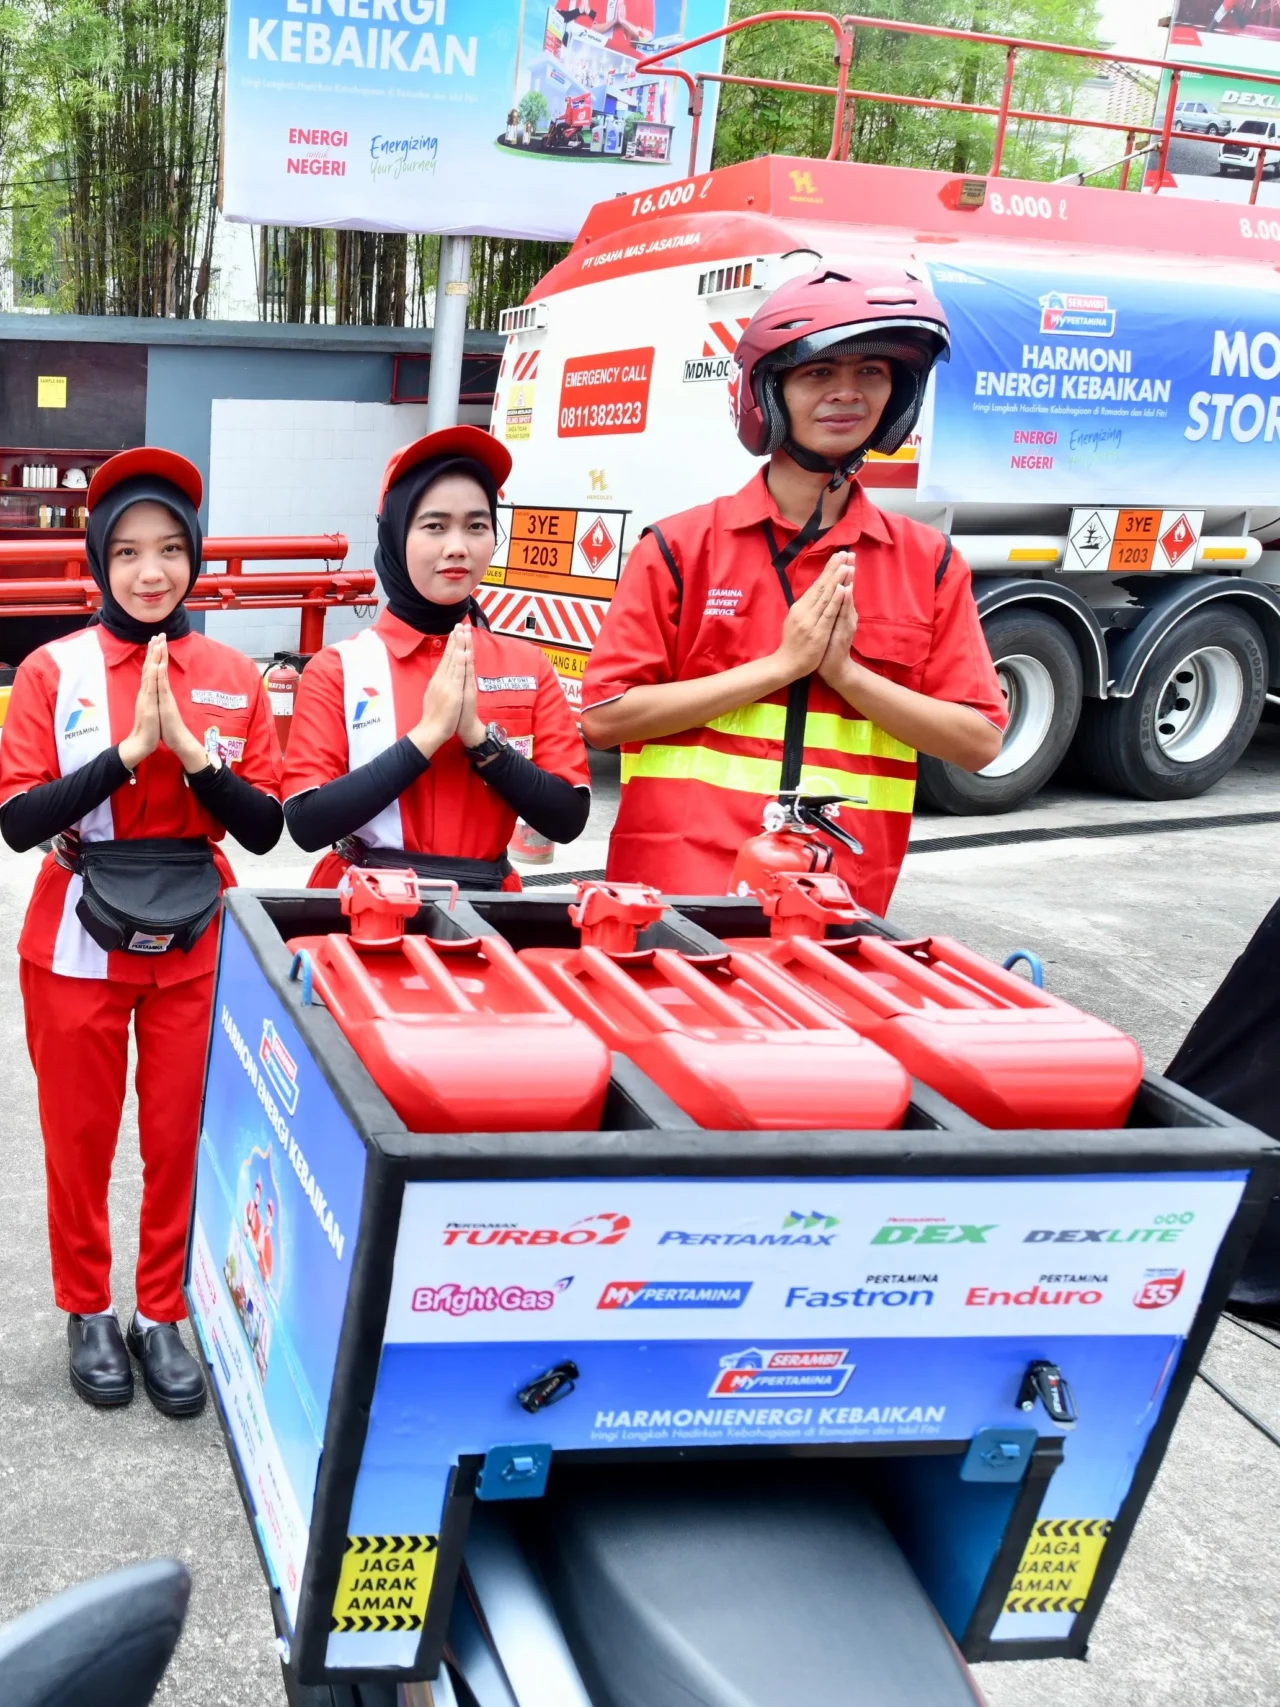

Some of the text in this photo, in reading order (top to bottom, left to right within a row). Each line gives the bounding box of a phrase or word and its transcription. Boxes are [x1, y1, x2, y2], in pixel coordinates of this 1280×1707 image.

[248, 17, 478, 77] KEBAIKAN
[1221, 90, 1280, 108] DEXL
[289, 128, 348, 147] ENERGI
[369, 134, 439, 162] Energizing
[286, 158, 346, 177] NEGERI
[370, 157, 437, 182] Your Journey
[631, 183, 695, 217] 16.000
[989, 192, 1052, 219] 8.000
[581, 232, 701, 270] PT USAHA MAS JASATAMA
[1067, 297, 1105, 310] SERAMBI
[1050, 313, 1107, 328] MyPERTAMINA
[1022, 344, 1132, 373] HARMONI
[1210, 330, 1280, 380] MO
[565, 365, 647, 388] EMERGENCY CALL
[975, 371, 1171, 403] ENERGI KEBAIKAN
[560, 401, 642, 428] 0811382323
[973, 402, 990, 413] Iringi
[991, 403, 1018, 414] Langkah
[1020, 403, 1049, 414] Hadirkan
[1050, 404, 1091, 417] Kebahagiaan
[1093, 406, 1099, 415] di
[1101, 406, 1129, 417] Ramadan
[1130, 408, 1142, 417] dan
[1014, 430, 1057, 445] ENERGI
[1071, 428, 1122, 451] Energizing
[1011, 455, 1053, 469] NEGERI
[527, 515, 560, 535] 3YE
[1125, 517, 1153, 533] 3YE
[522, 545, 558, 567] 1203
[592, 556, 598, 566] 3
[1118, 548, 1149, 564] 1203
[1171, 551, 1178, 561] 3
[708, 589, 743, 597] TAMINA
[65, 726, 99, 740] PERTAMINA
[131, 943, 164, 951] PERTAMINA
[221, 1004, 258, 1088] HARMONI
[257, 1075, 289, 1152] ENERGI
[288, 1137, 345, 1261] KEBAIKAN
[446, 1221, 518, 1229] PERTAMAX
[657, 1231, 838, 1246] PERTAMAX
[870, 1224, 1000, 1245] DEX
[1023, 1228, 1183, 1244] DEXLITE
[866, 1273, 939, 1284] PERTAMINA
[1039, 1274, 1109, 1283] PERTAMINA
[498, 1287, 554, 1311] Gas
[604, 1287, 742, 1308] MyPERTAMINA
[785, 1286, 934, 1308] Fastron
[965, 1285, 1103, 1307] Enduro
[771, 1354, 840, 1367] SERAMBI
[731, 1374, 833, 1390] MyPERTAMINA
[595, 1406, 945, 1428] HARMONIENERGI KEBAIKAN
[591, 1430, 619, 1442] Iringi
[621, 1429, 669, 1441] Langkah
[671, 1428, 723, 1439] Hadirkan
[727, 1427, 800, 1440] Kebahagiaan
[803, 1427, 815, 1437] di
[818, 1426, 870, 1437] Ramadan
[873, 1426, 894, 1436] dan
[1029, 1541, 1080, 1555] JAGA
[359, 1558, 415, 1572] JAGA
[1017, 1560, 1080, 1574] JARAK
[349, 1577, 418, 1592] JARAK
[1011, 1579, 1072, 1592] AMAN
[347, 1596, 413, 1611] AMAN
